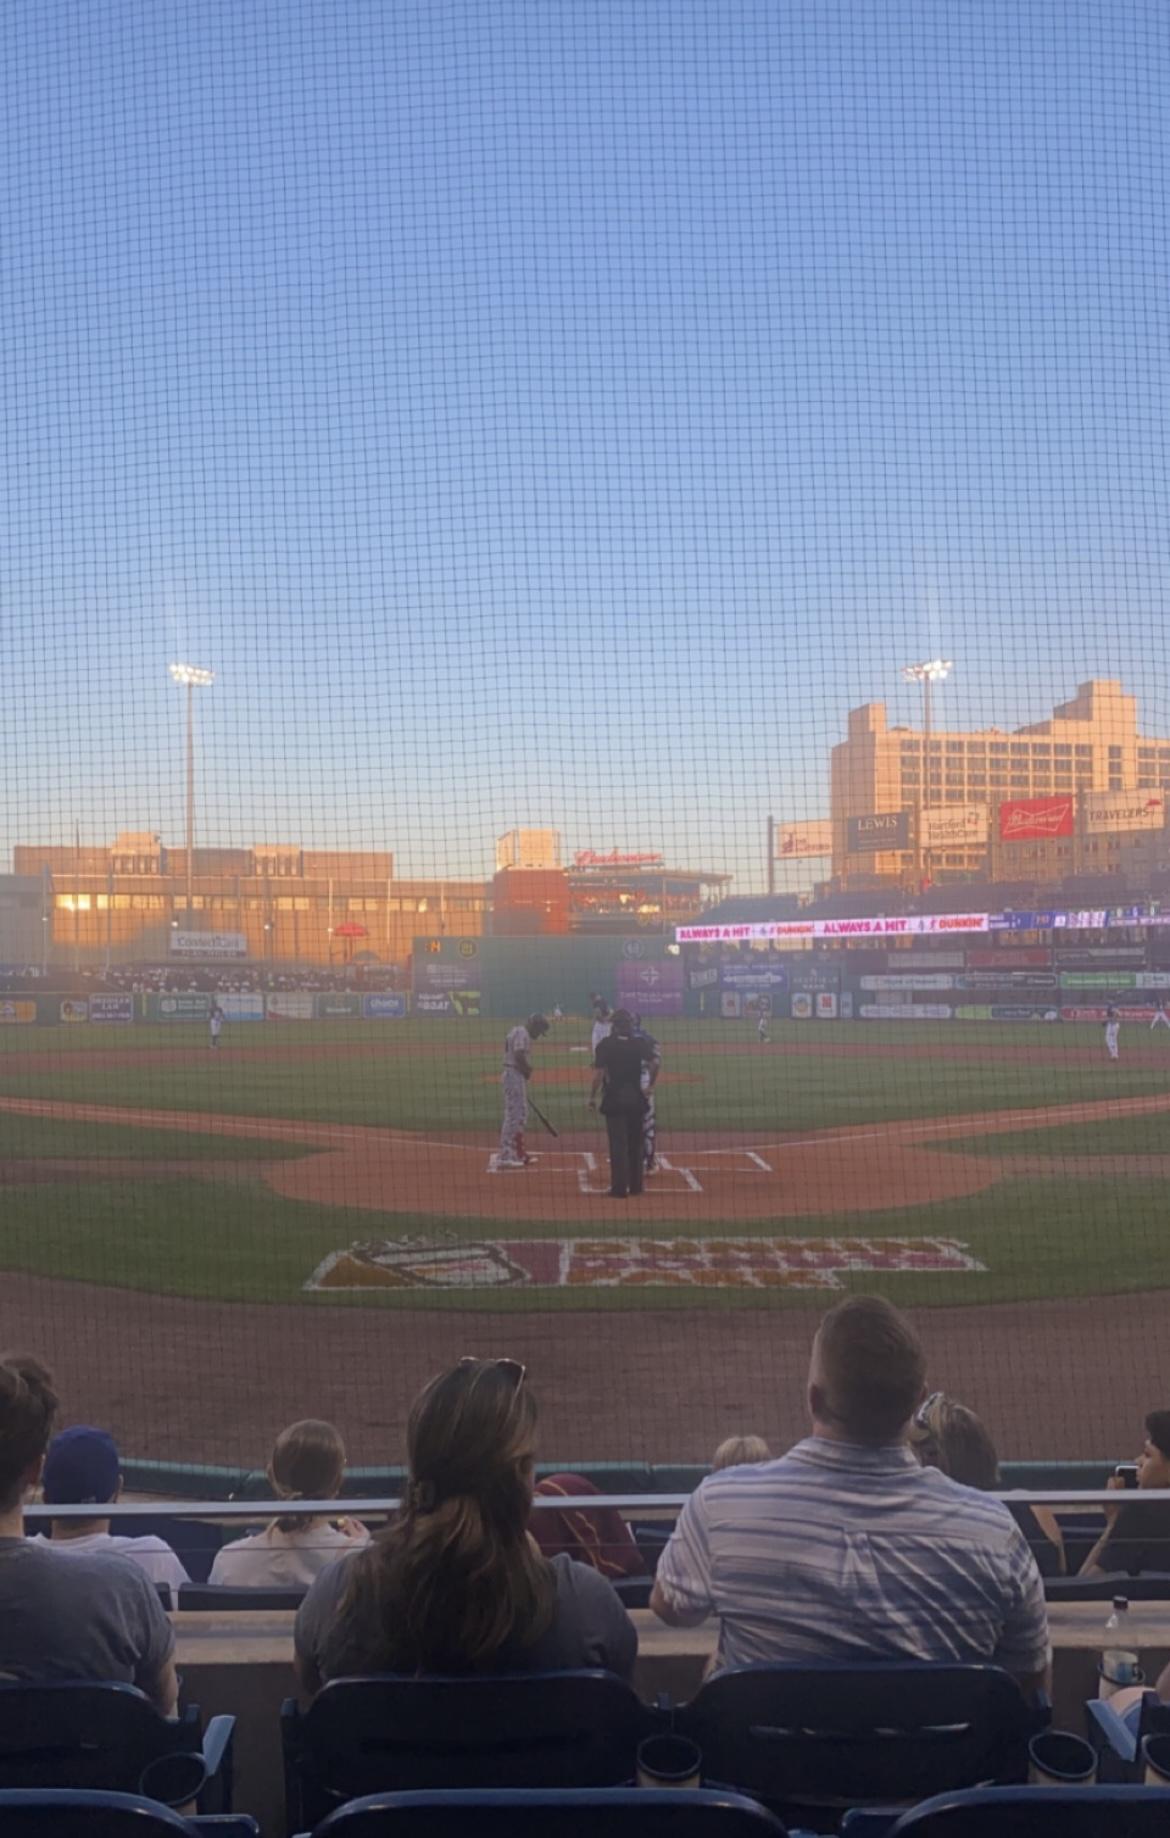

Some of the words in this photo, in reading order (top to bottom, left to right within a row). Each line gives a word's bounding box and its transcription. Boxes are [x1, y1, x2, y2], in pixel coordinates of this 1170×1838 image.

[1090, 807, 1148, 820] TRAVELERS
[857, 816, 898, 831] LEWIS
[823, 921, 870, 933] ALWAYS
[873, 921, 881, 931] A
[885, 920, 907, 931] HIT
[939, 918, 983, 929] DUNKIN'
[680, 928, 720, 939] ALWAYS
[723, 928, 730, 937] A
[732, 927, 750, 936] HIT
